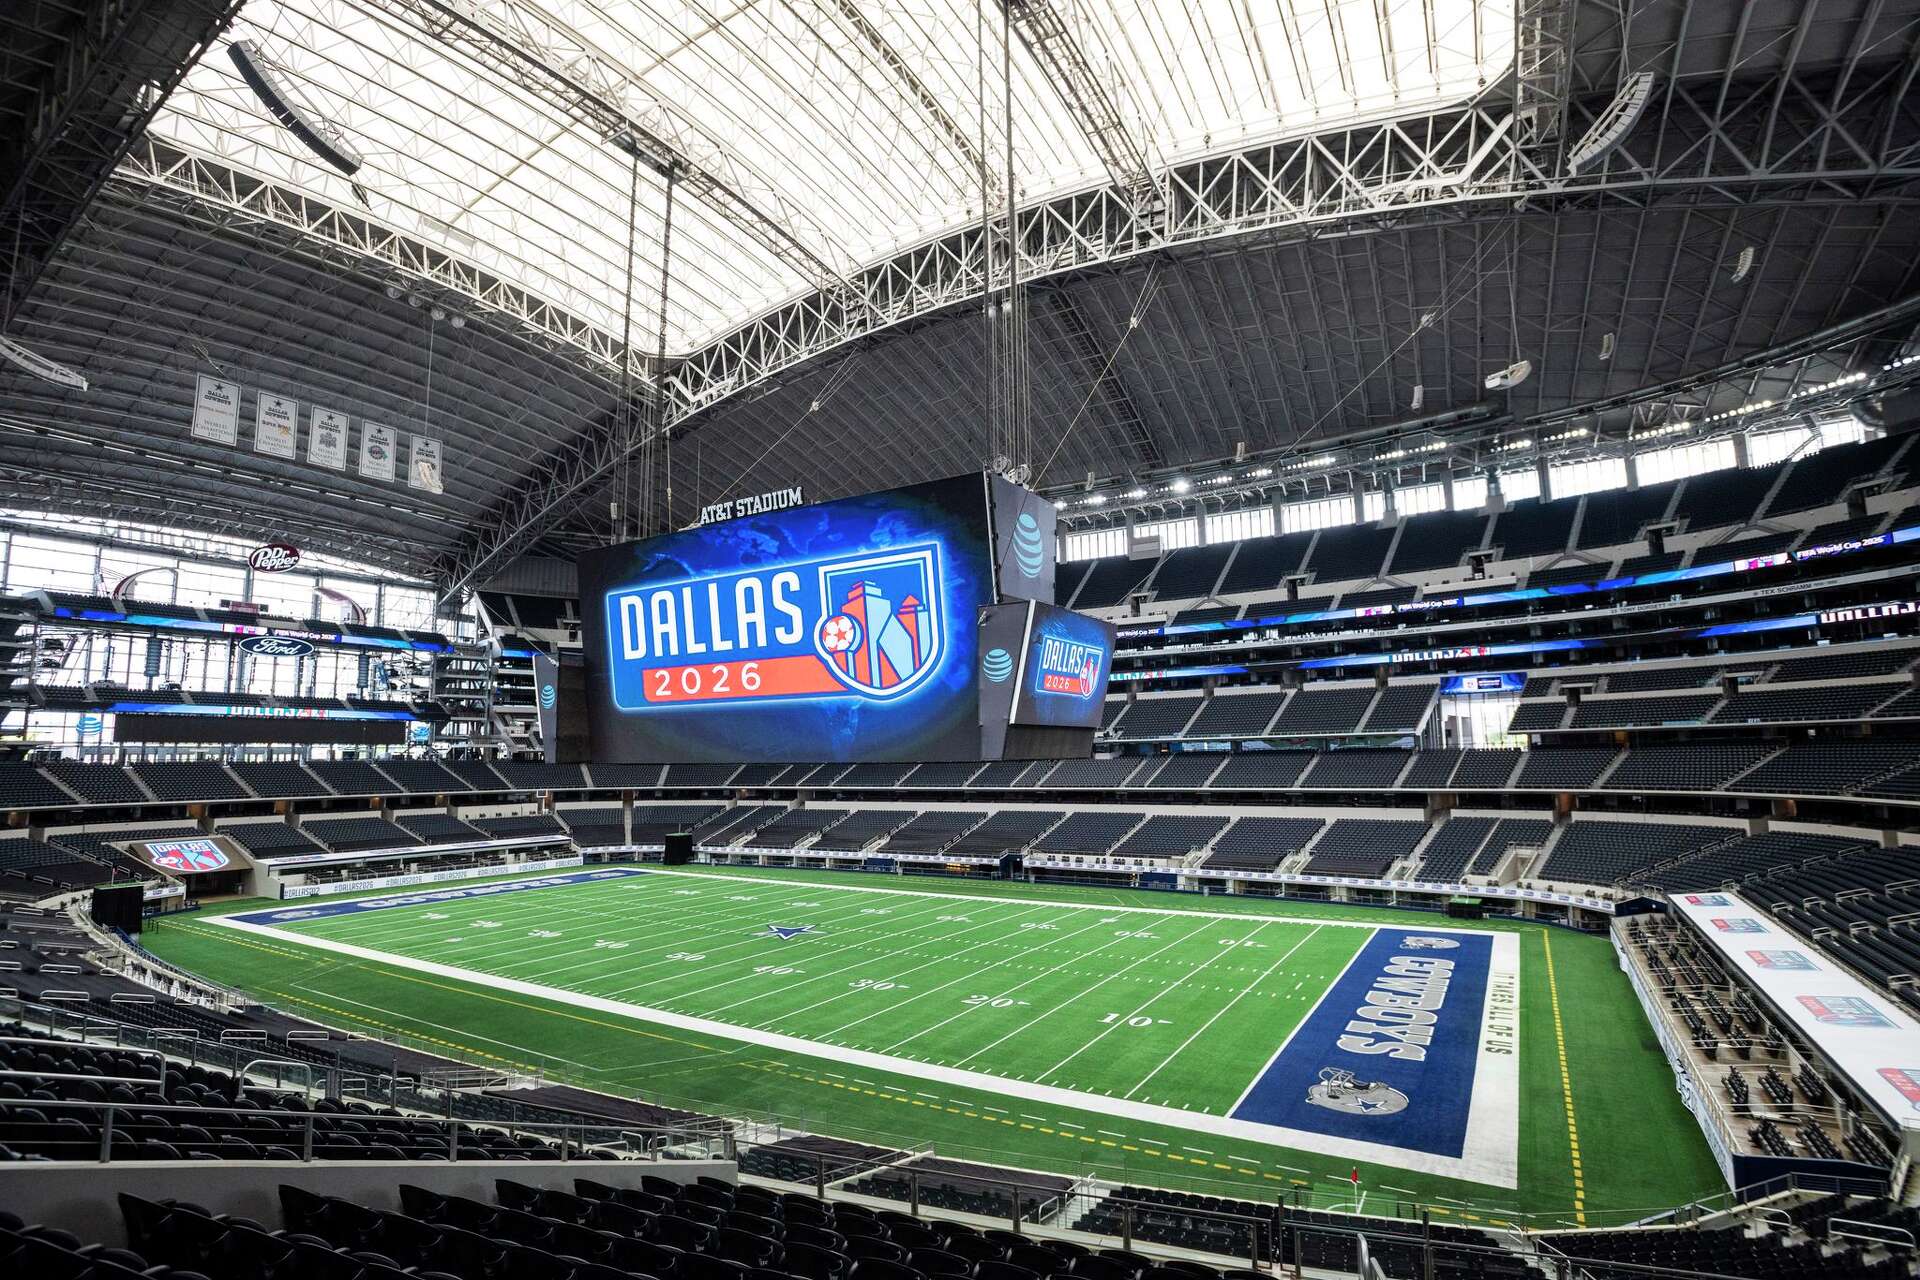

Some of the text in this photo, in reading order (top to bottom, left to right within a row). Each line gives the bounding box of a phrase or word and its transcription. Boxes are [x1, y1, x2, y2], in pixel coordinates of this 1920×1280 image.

[700, 486, 803, 525] AT&T STADIUM
[1843, 541, 1862, 550] Cup
[251, 547, 299, 570] Pepper
[272, 547, 290, 560] Dr
[619, 571, 803, 661] DALLAS
[253, 638, 302, 655] Ford
[1042, 639, 1084, 675] DALLAS
[654, 662, 761, 697] 2026
[1046, 675, 1070, 690] 2026
[156, 842, 210, 853] DALLAS
[960, 994, 1014, 1008] 20
[1336, 955, 1456, 1062] COWBOYS
[1097, 1012, 1153, 1027] 10
[1488, 1005, 1514, 1020] ALL
[1487, 1024, 1513, 1038] OF
[1485, 1040, 1513, 1055] US
